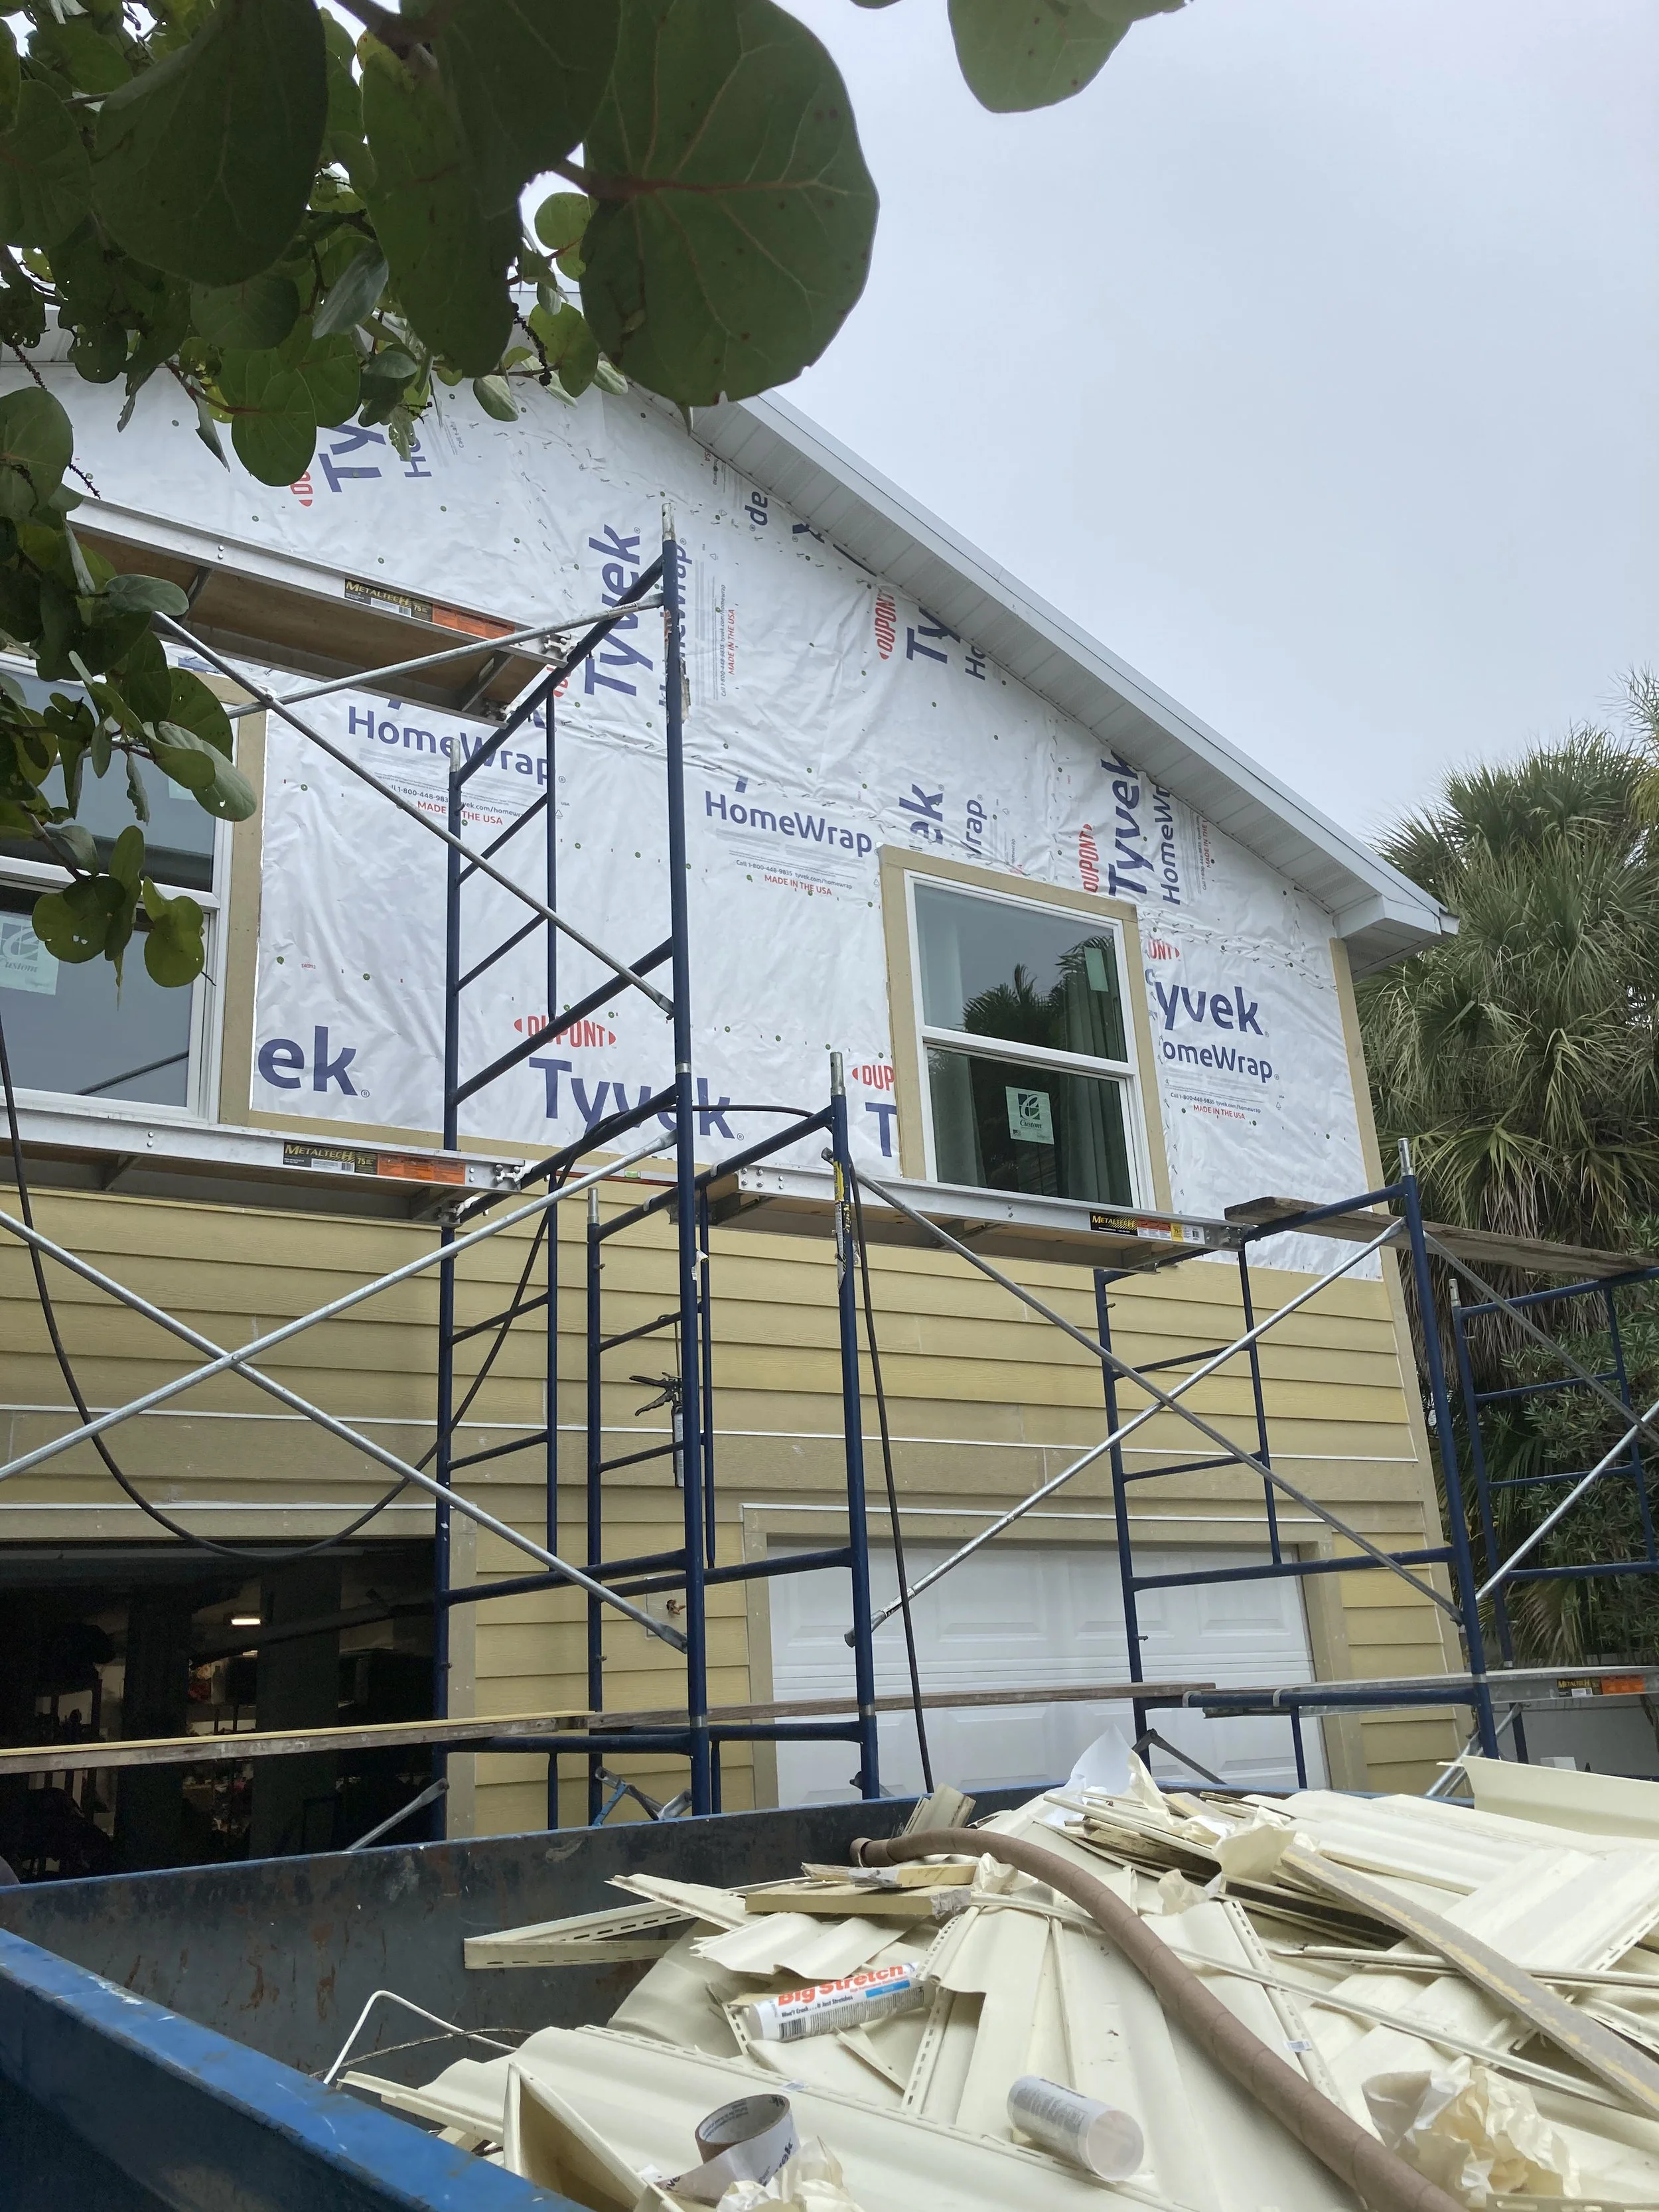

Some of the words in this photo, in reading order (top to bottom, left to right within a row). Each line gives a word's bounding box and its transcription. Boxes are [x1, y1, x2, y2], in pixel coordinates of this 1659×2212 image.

[727, 642, 734, 651] IN
[417, 800, 447, 814] MADE
[461, 810, 480, 821] THE
[483, 813, 503, 825] USA
[1100, 749, 1155, 897] Tyvek
[705, 790, 872, 858] HomeWrap
[736, 859, 747, 867] Call
[748, 862, 793, 877] 1-800-448-9835
[1078, 830, 1099, 893] DUPONT
[764, 874, 788, 885] MADE
[790, 879, 799, 888] IN
[800, 881, 814, 892] THE
[816, 885, 833, 896] USA
[529, 1057, 735, 1140] Tyvk
[1193, 1104, 1211, 1114] MADE
[1221, 1109, 1233, 1118] THE
[1234, 1111, 1246, 1120] USA
[1019, 1119, 1043, 1129] Custom
[778, 1986, 816, 2006] Big
